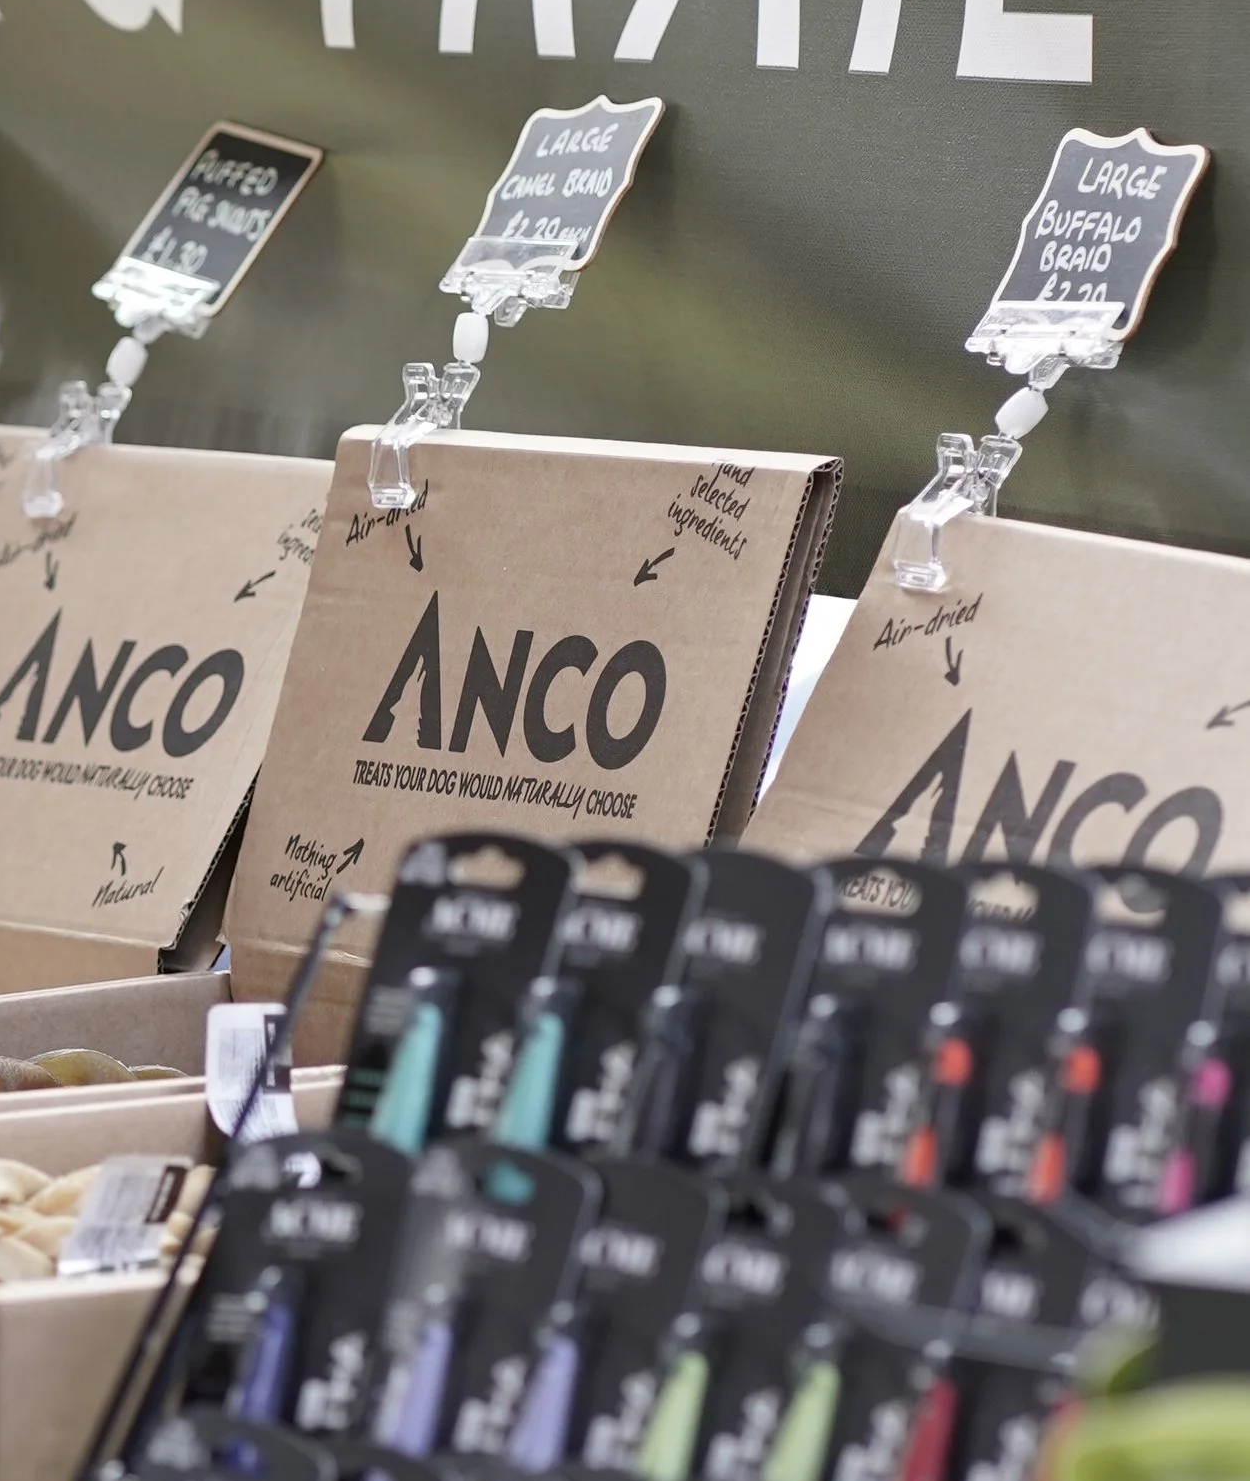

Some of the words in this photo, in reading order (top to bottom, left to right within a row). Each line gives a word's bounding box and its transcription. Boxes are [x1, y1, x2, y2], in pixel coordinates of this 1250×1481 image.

[536, 122, 620, 158] LARGE
[189, 148, 280, 197] PUFFED
[561, 166, 614, 198] BRAID
[1077, 157, 1168, 201] LARGE
[1034, 199, 1143, 244] BUFFALO
[1039, 239, 1113, 273] BRAID
[690, 474, 752, 522] selected
[667, 493, 748, 561] ingredients
[872, 591, 984, 651] Air-dried
[361, 589, 667, 770] ANCO
[147, 773, 195, 800] CHOOSE
[352, 759, 394, 789] TREATS
[393, 764, 427, 792] YOUR
[426, 769, 458, 795] DOG
[458, 771, 503, 801] WOULD
[501, 774, 587, 820] NATURALLY
[586, 789, 638, 820] CHOOSE
[852, 706, 1225, 881] ANCO
[284, 833, 338, 880] Nothing
[91, 865, 166, 908] Natural
[269, 868, 333, 902] artificial
[840, 873, 885, 906] REATS
